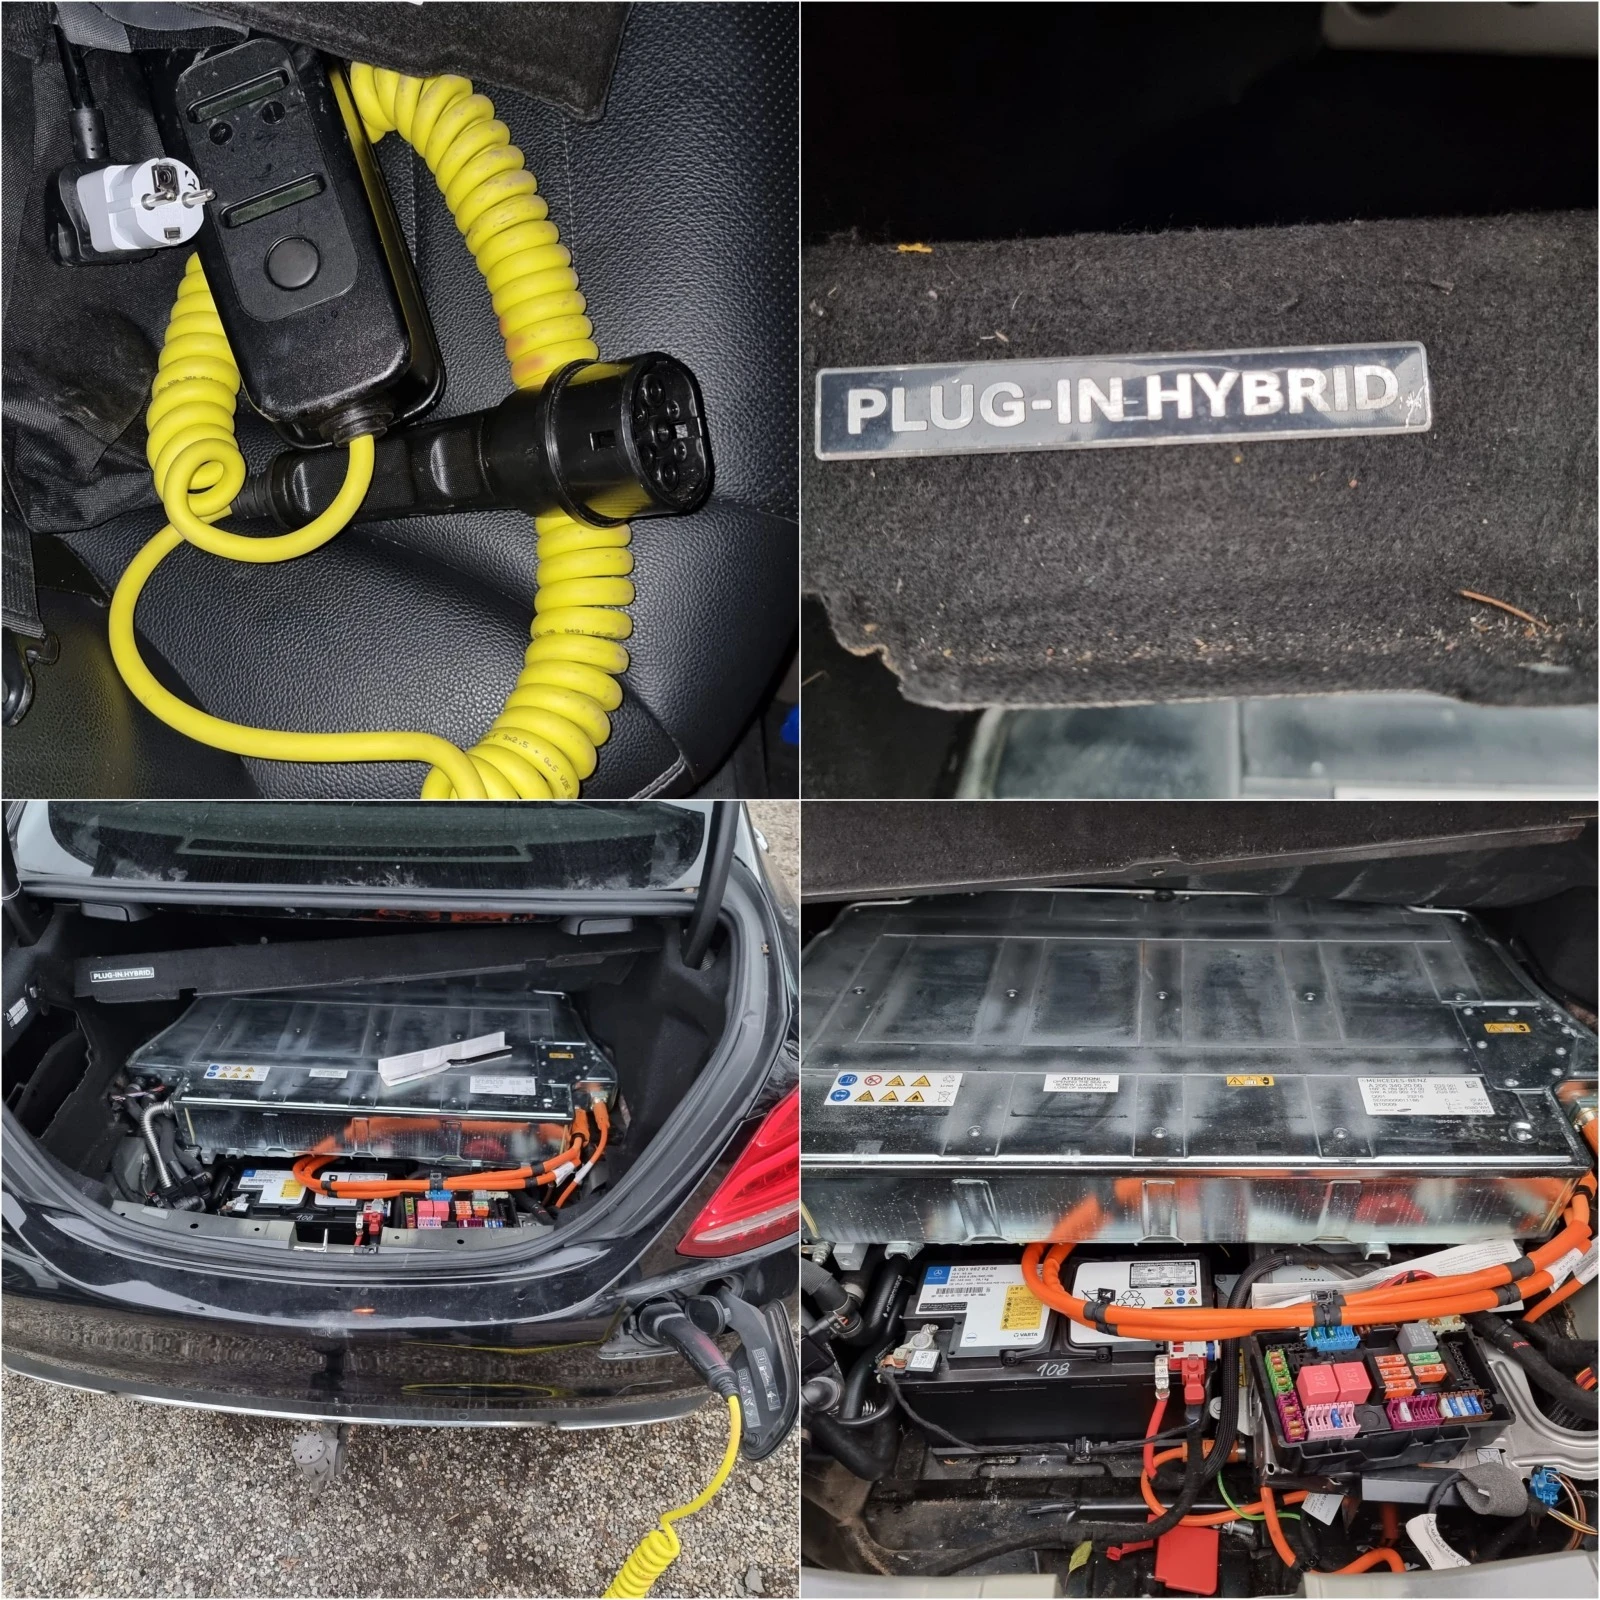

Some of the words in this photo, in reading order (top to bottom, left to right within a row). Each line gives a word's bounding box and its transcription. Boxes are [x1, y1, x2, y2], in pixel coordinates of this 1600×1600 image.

[847, 376, 1126, 435] PLUG-IN
[1145, 364, 1399, 421] HYBRID
[559, 774, 572, 791] VDE
[93, 971, 123, 980] PLUG-IN
[124, 969, 151, 977] HYBRID
[1036, 1362, 1070, 1377] 108
